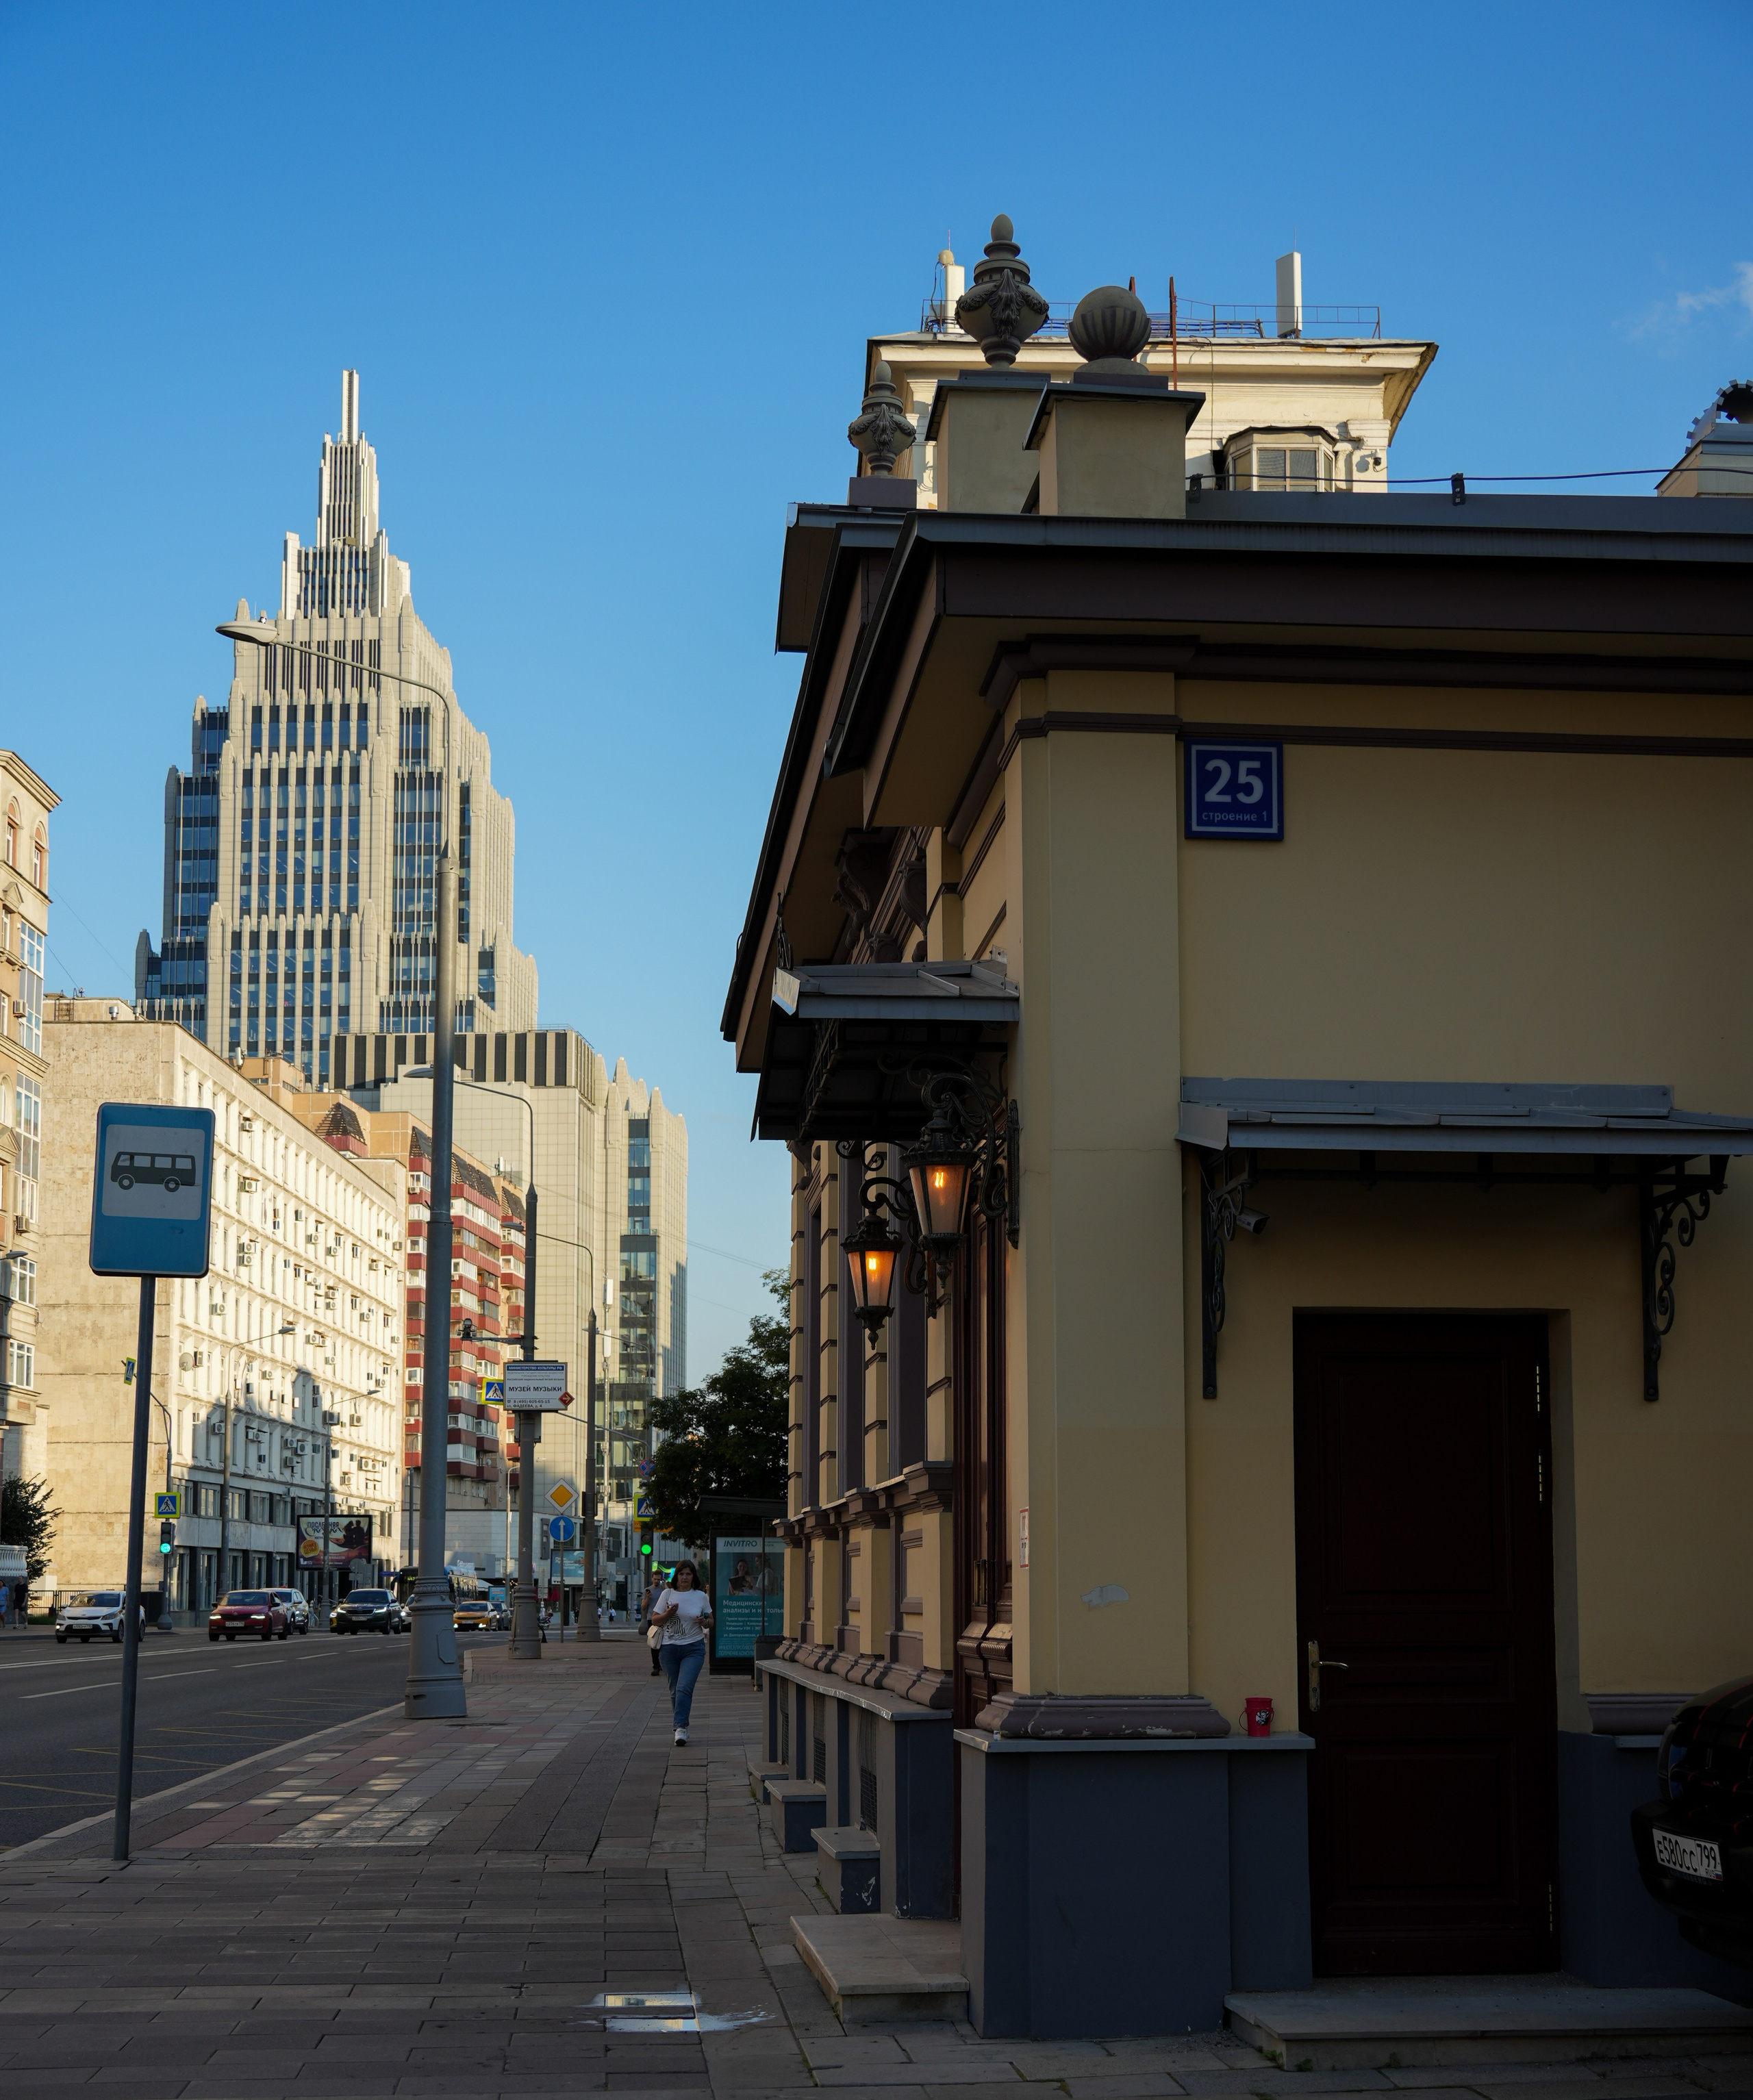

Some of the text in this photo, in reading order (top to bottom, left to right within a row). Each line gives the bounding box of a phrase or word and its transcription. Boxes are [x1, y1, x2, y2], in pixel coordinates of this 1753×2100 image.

[1204, 759, 1263, 804] 25
[1202, 811, 1267, 823] строение 1
[1657, 1836, 1716, 1873] Е580СС 799
[1705, 1869, 1715, 1877] RUS
